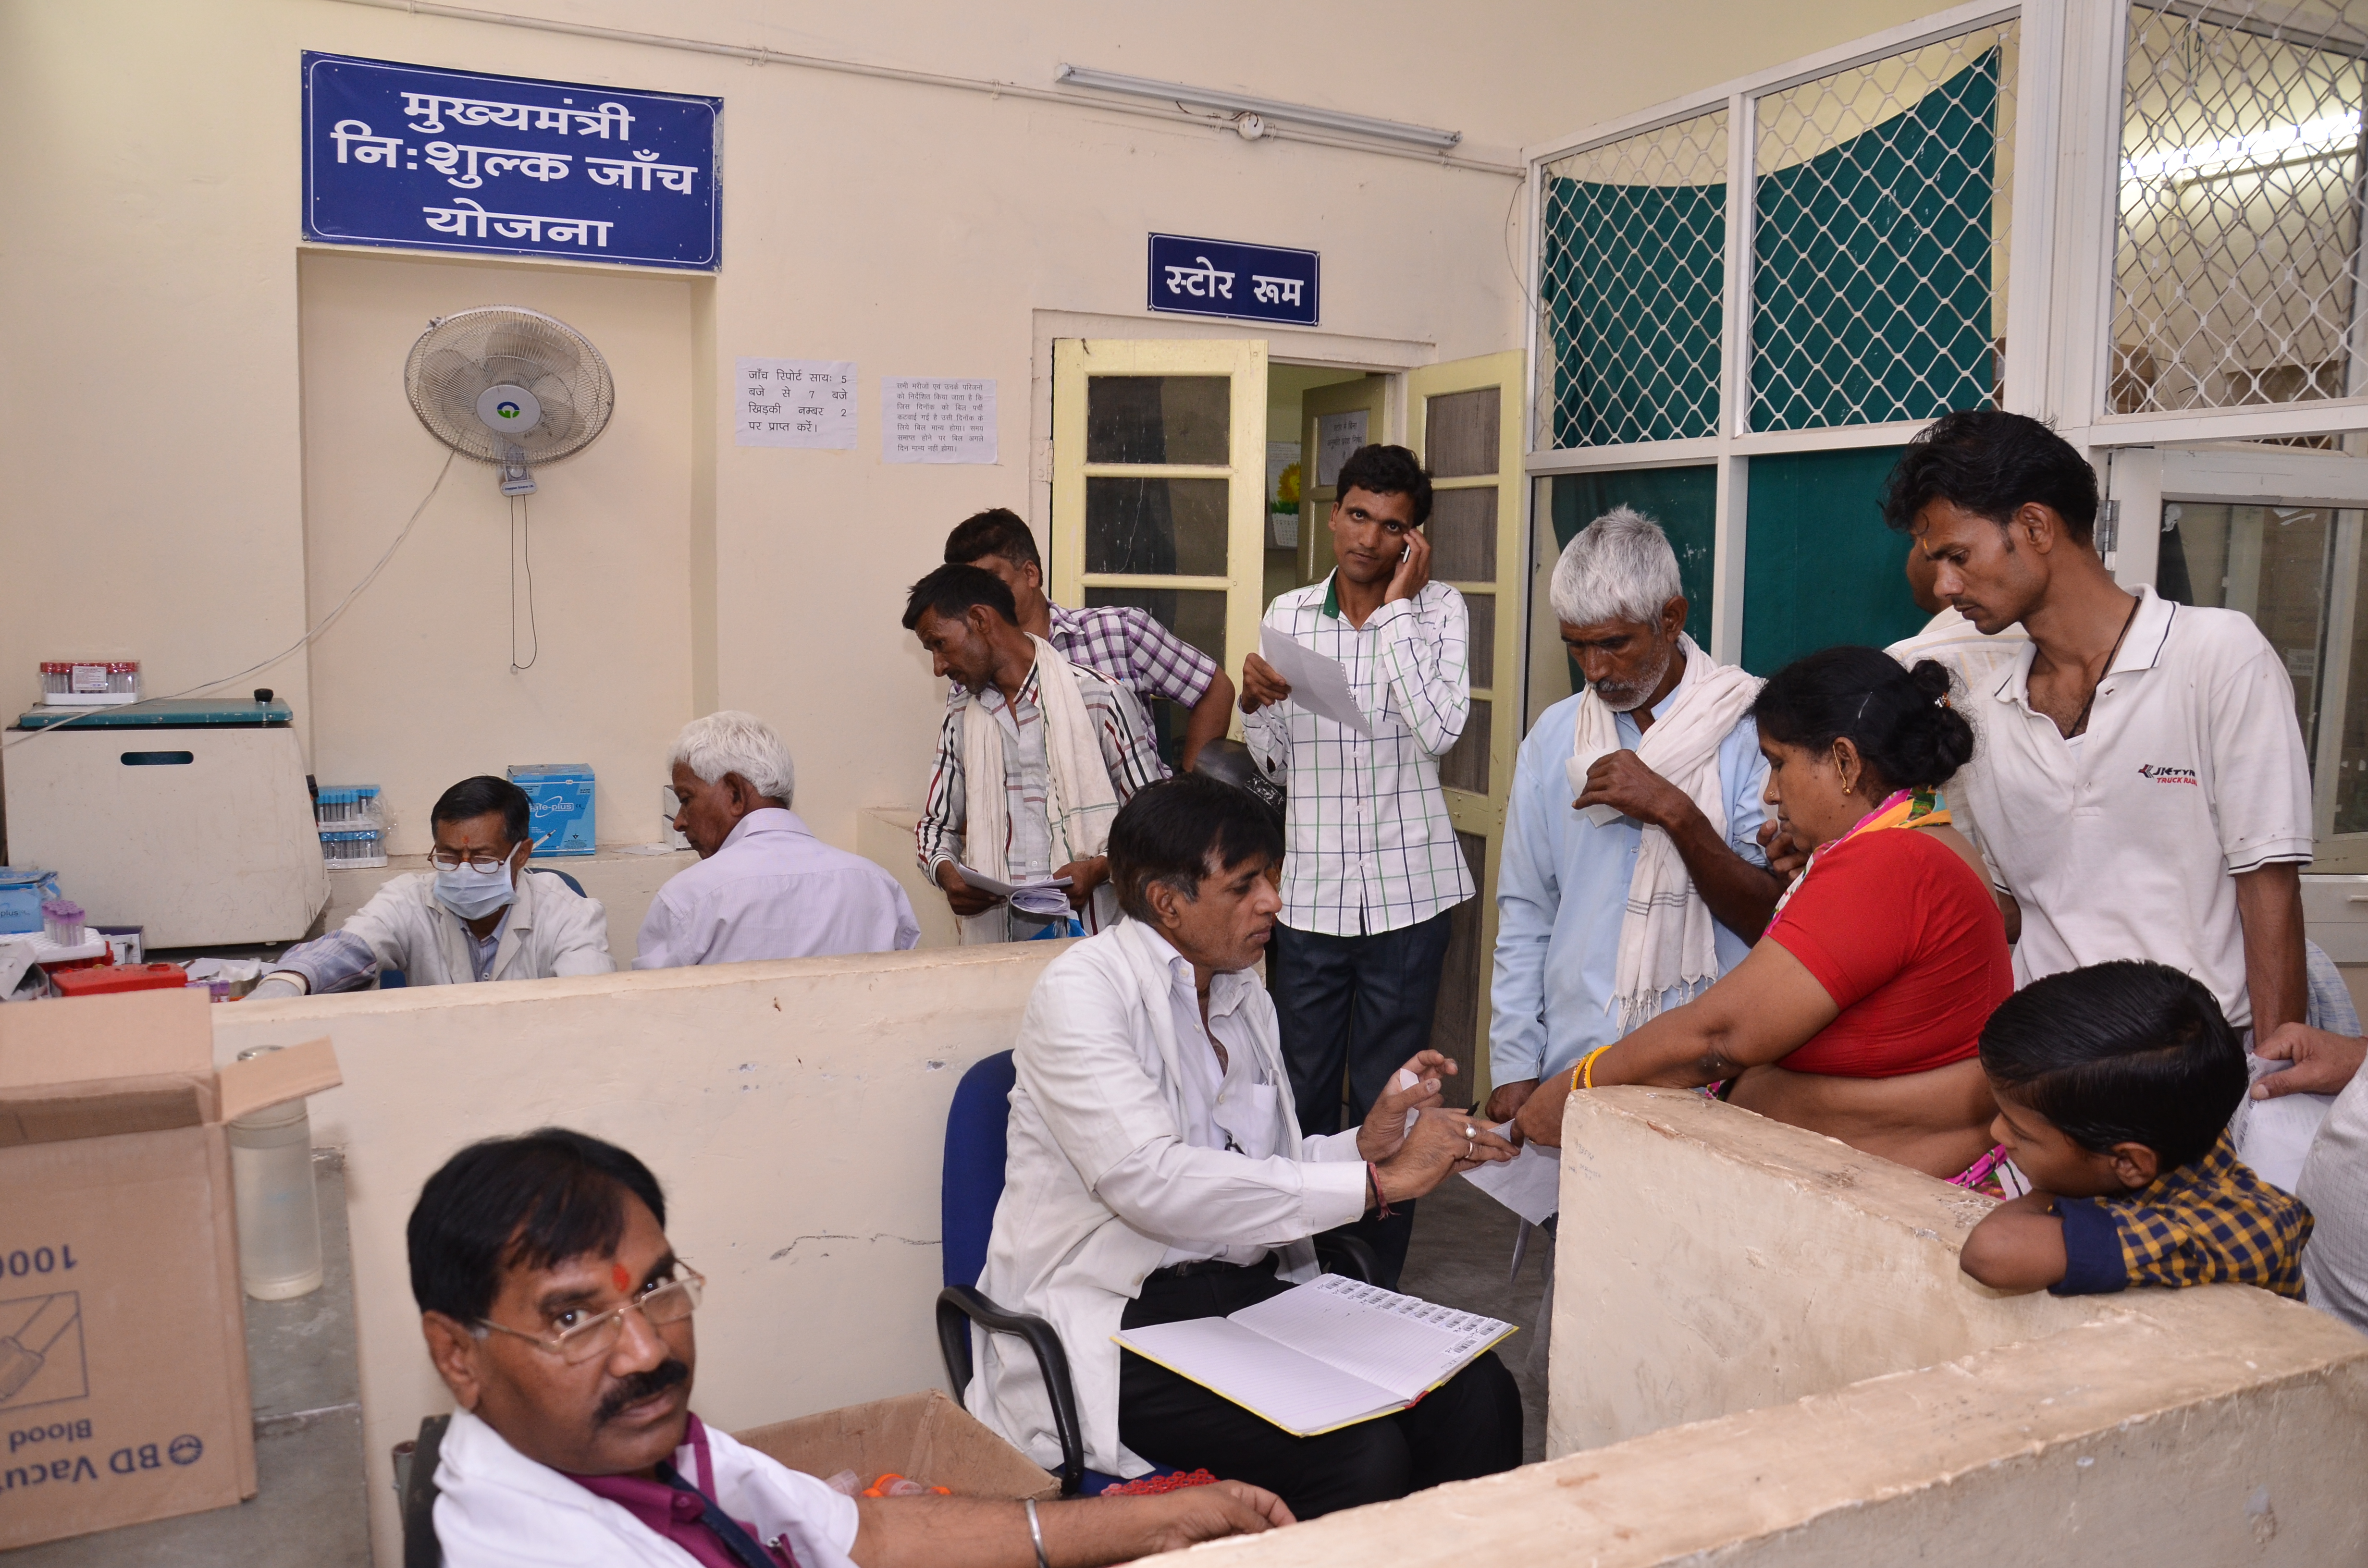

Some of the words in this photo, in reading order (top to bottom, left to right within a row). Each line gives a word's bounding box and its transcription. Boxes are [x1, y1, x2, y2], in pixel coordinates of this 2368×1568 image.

[401, 92, 635, 141] मुख्यमंत्री
[585, 148, 698, 194] जाँच
[423, 198, 613, 246] योजना
[1165, 256, 1235, 299] स्टोर
[1252, 275, 1304, 306] रूम
[748, 384, 765, 397] बजे
[781, 386, 791, 398] से
[809, 391, 815, 399] 7
[832, 388, 848, 400] बजे
[749, 368, 769, 380] जाँच
[777, 368, 802, 381] रिपोर्ट
[841, 375, 847, 384] 5
[748, 401, 782, 415] खिड़की
[798, 406, 825, 416] नम्बर
[841, 409, 847, 417] 2
[897, 413, 917, 421] कटवाई
[921, 413, 929, 421] गई
[748, 422, 762, 430] पर
[768, 422, 790, 431] प्राप्त
[0, 1244, 77, 1277] 100
[9, 1418, 93, 1453] Blood
[0, 1456, 98, 1493] Vacu
